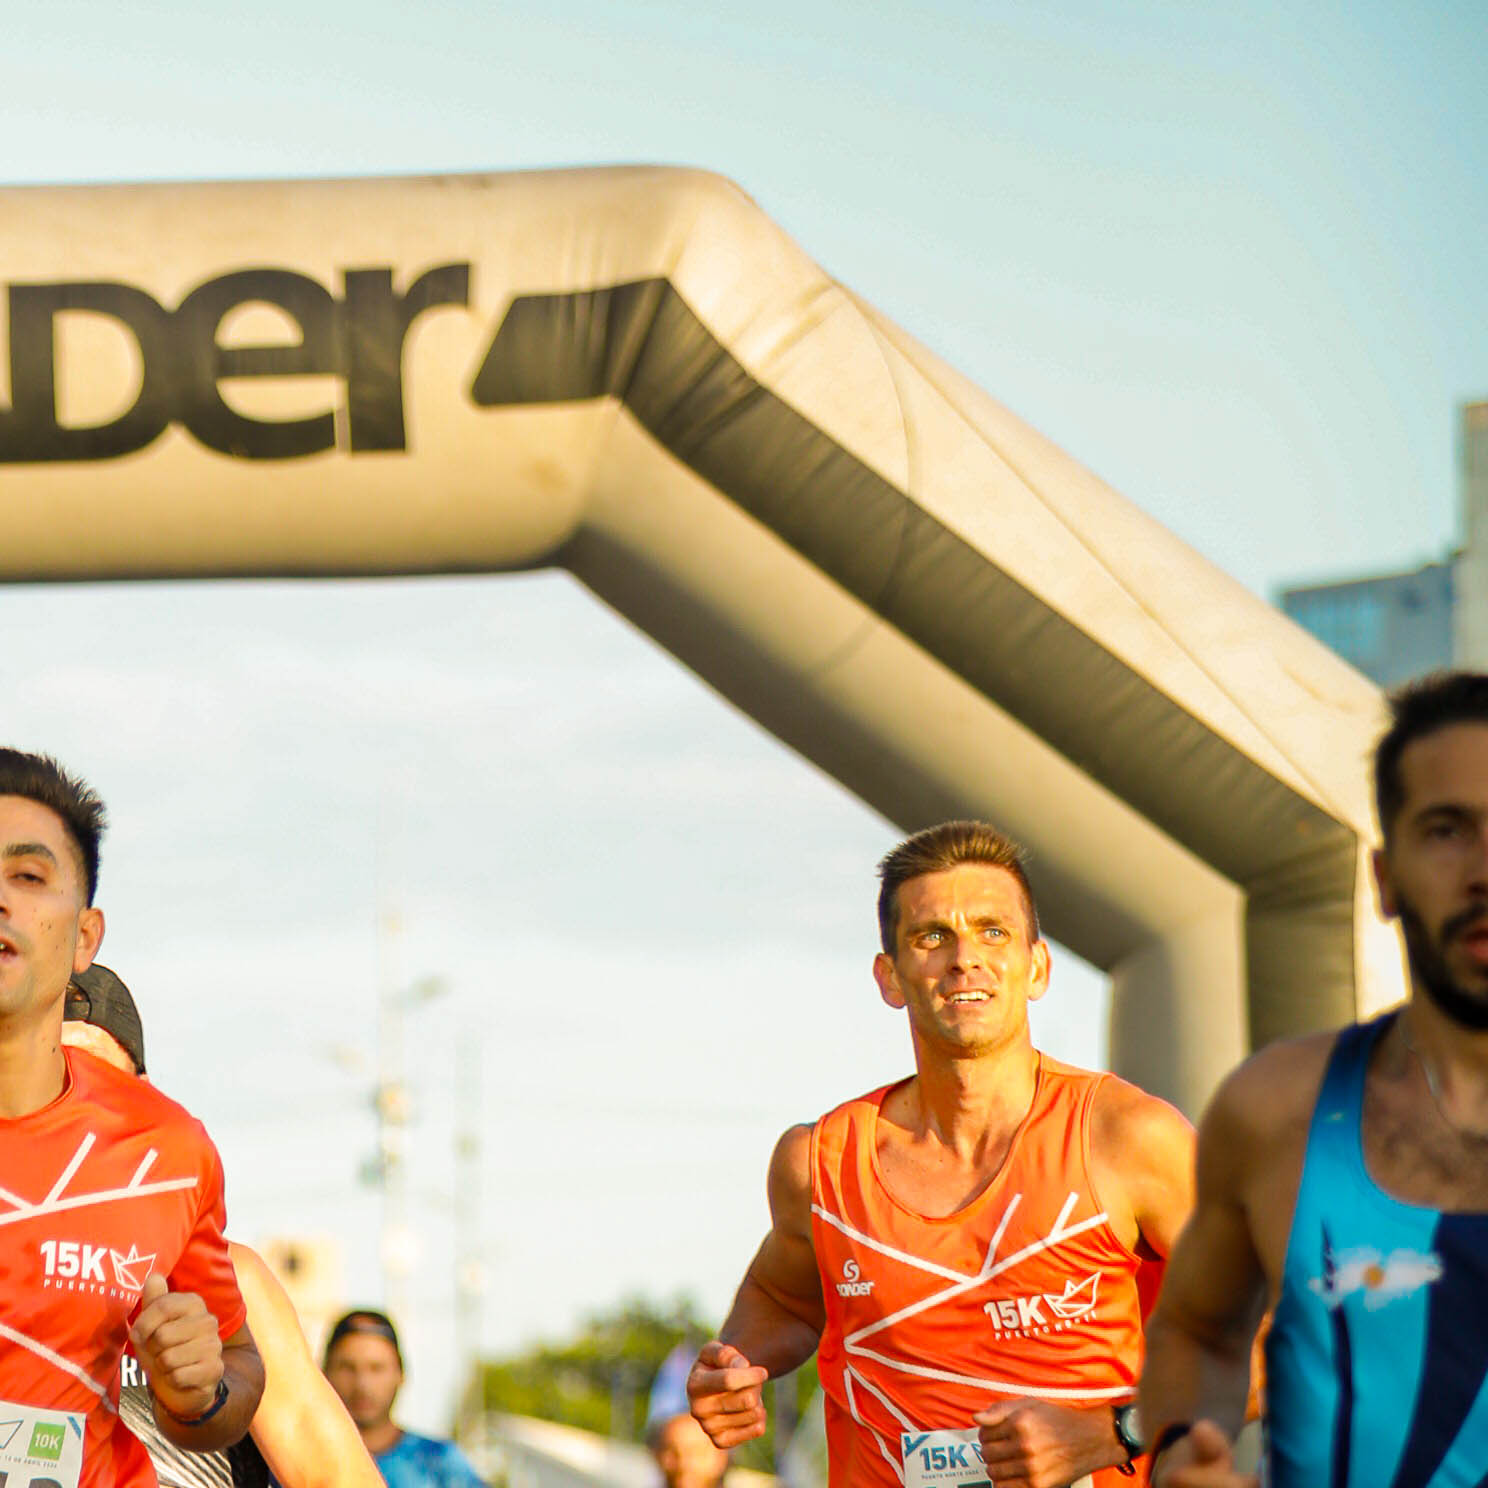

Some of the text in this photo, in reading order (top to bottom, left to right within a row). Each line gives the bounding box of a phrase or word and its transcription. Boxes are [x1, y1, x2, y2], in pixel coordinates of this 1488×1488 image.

[40, 1240, 108, 1282] 15K
[44, 1279, 105, 1295] PUERTO
[983, 1295, 1048, 1331] 15K
[34, 1433, 60, 1450] 10K
[920, 1444, 969, 1471] 15K
